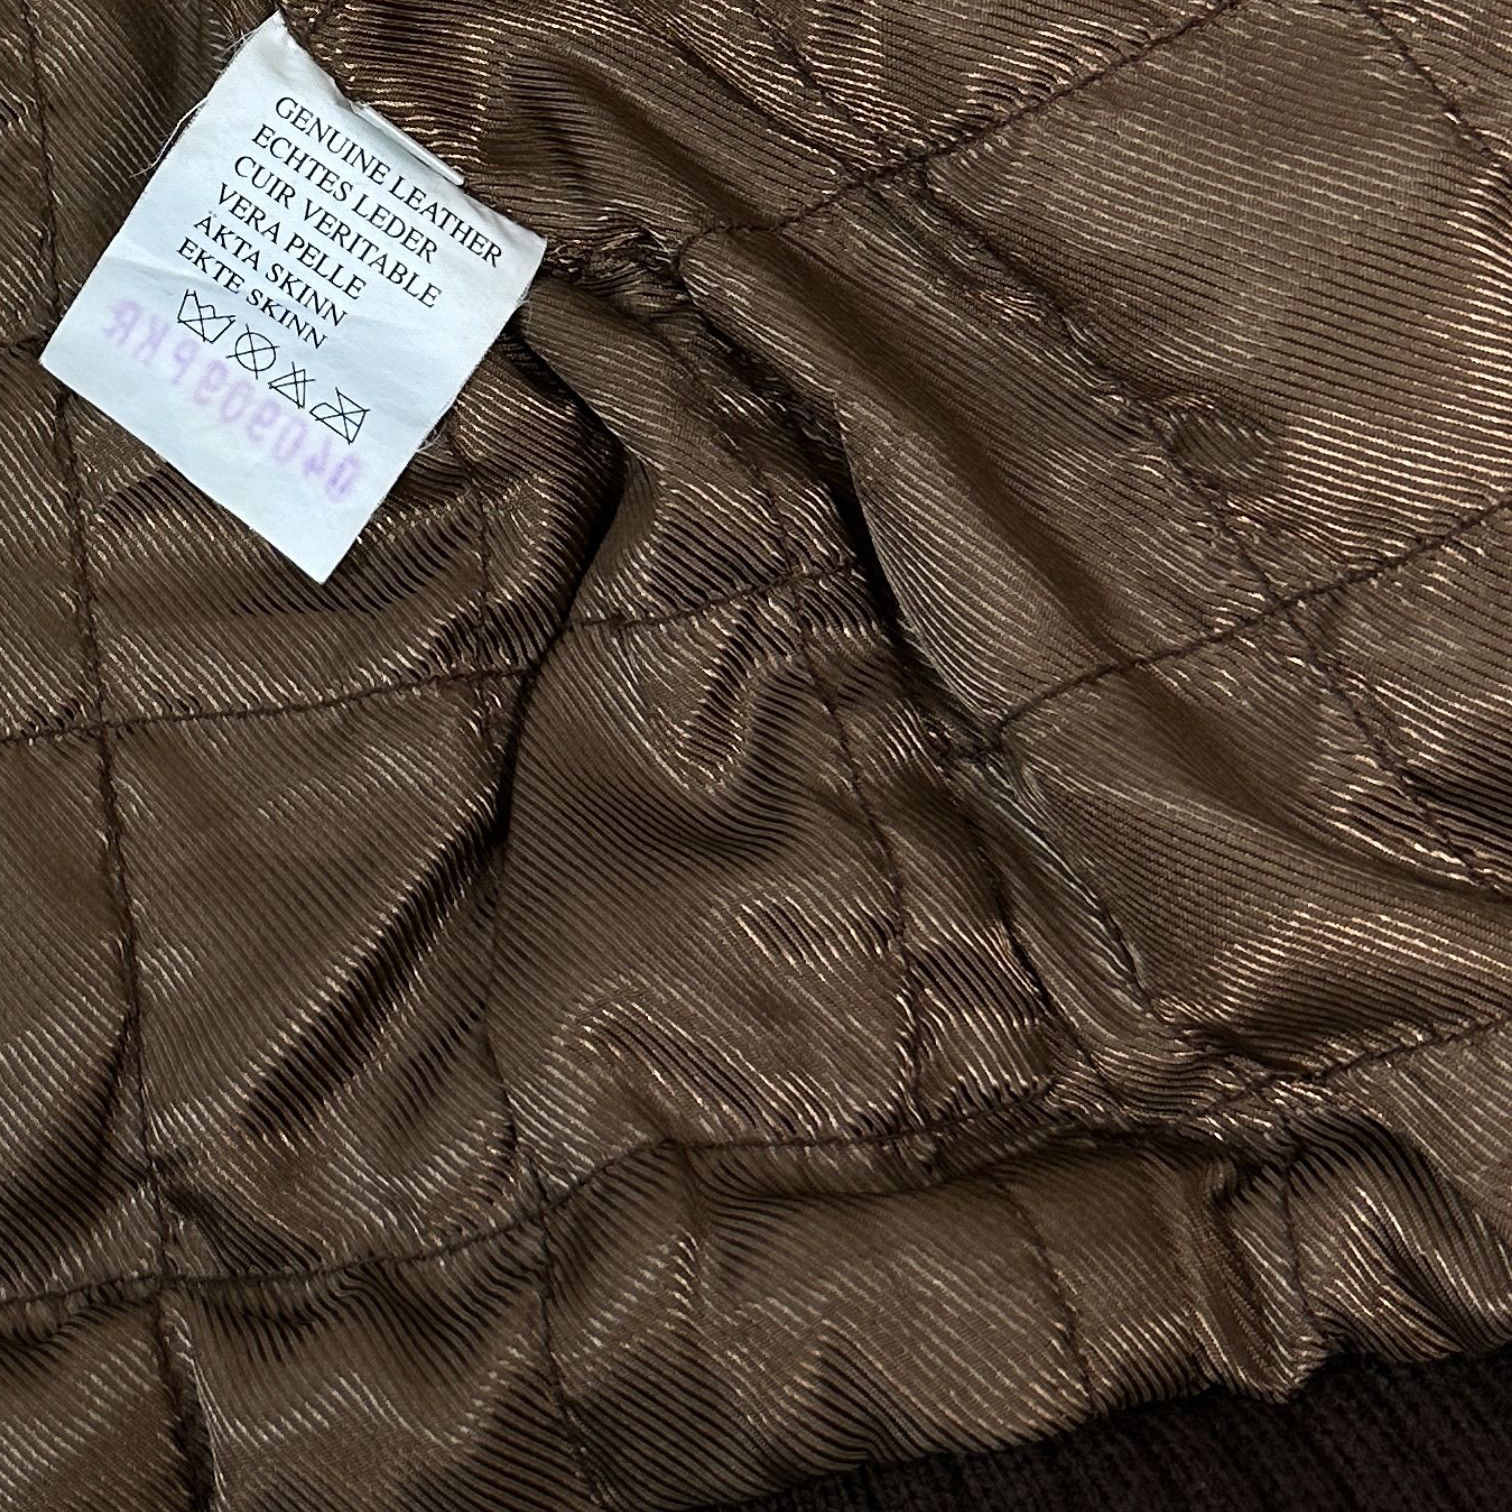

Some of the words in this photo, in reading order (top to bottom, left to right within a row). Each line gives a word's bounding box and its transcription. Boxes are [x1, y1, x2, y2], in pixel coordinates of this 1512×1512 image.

[218, 182, 282, 245] VERA
[283, 232, 368, 300] PELLE
[234, 155, 297, 210] CUIR
[302, 198, 443, 308] VERITABLE
[252, 123, 354, 202] ECHTES
[351, 193, 439, 264] LEDER
[275, 96, 391, 185] GENUINE
[388, 176, 503, 268] LEATHER
[176, 236, 246, 295] EKTE
[245, 288, 328, 350] SKINN
[193, 210, 261, 272] ÄKTA
[265, 262, 348, 327] SKINN
